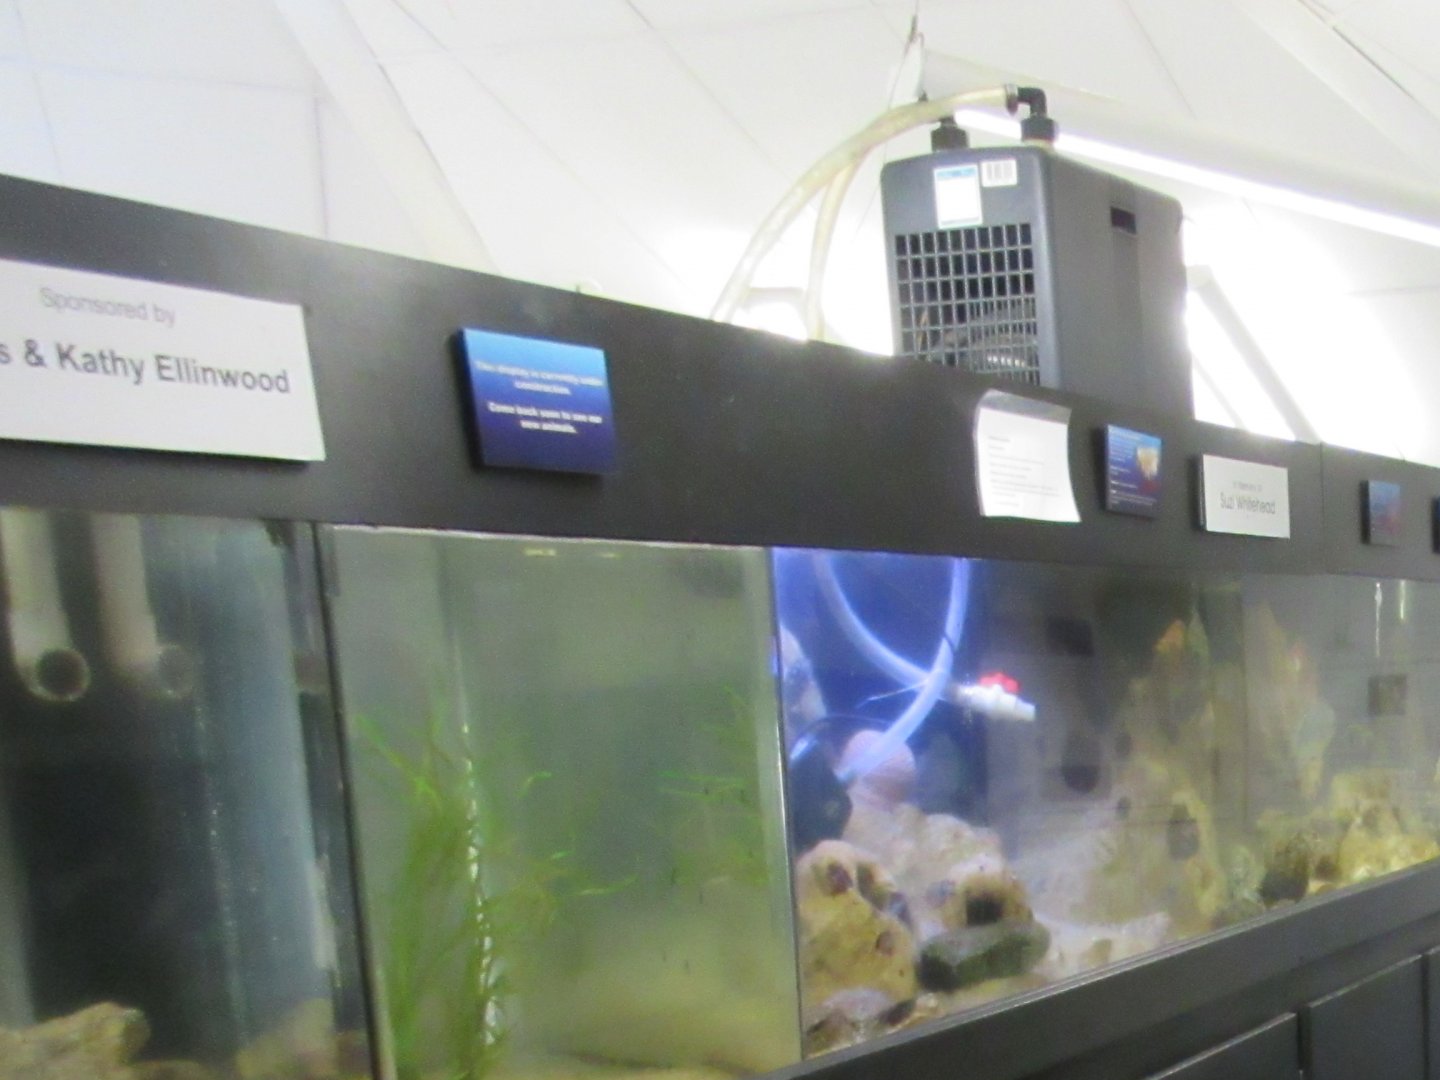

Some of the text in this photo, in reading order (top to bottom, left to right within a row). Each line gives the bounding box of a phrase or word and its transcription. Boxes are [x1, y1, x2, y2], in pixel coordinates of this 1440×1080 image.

[39, 287, 176, 328] Sponsored by
[24, 339, 47, 368] &
[55, 342, 145, 386] Kathy
[156, 354, 292, 394] Ellinwood
[487, 402, 515, 414] Come
[515, 405, 539, 417] back
[539, 409, 561, 418] soon
[572, 413, 588, 422] see
[1235, 496, 1276, 515] Whitehead
